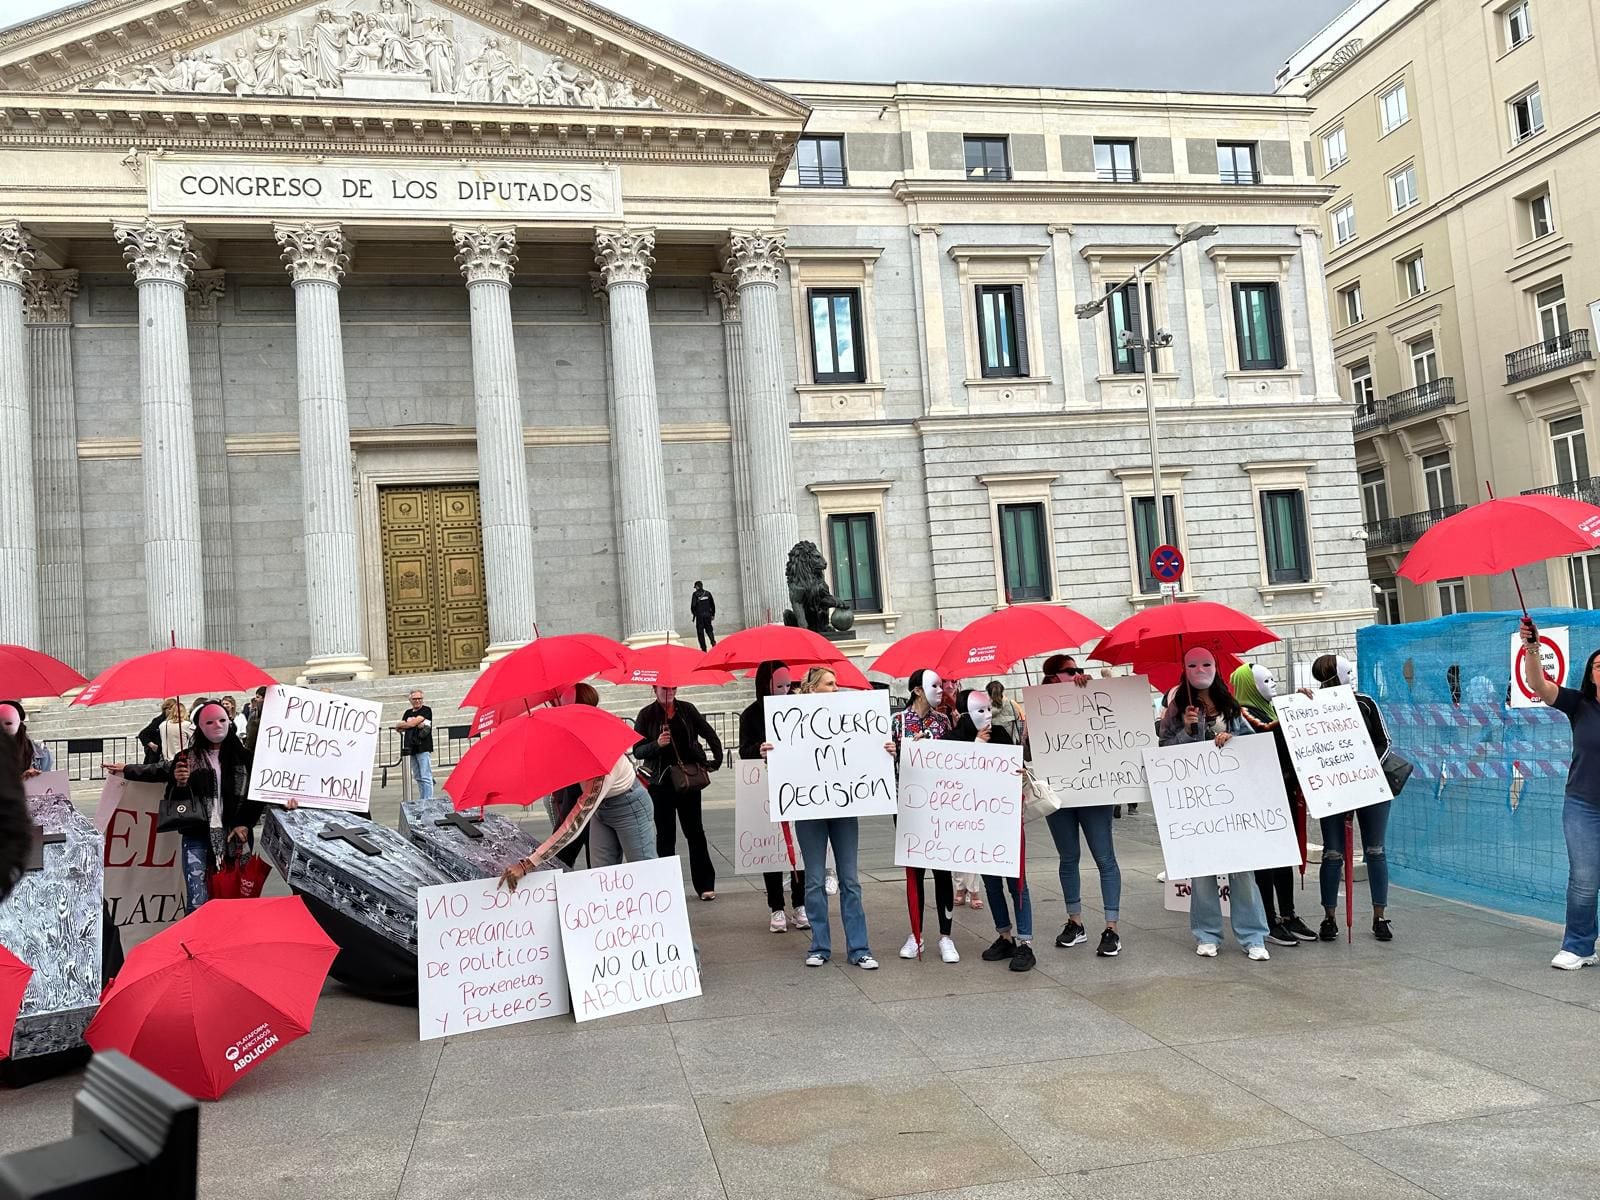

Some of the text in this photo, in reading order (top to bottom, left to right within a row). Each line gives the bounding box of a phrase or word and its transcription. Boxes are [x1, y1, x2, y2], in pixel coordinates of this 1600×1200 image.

[180, 176, 593, 202] CONGRESO DE LOS DIPUTADOS
[1038, 691, 1114, 717] DEJAR
[1089, 714, 1118, 730] DE
[1305, 722, 1318, 736] ES
[1318, 717, 1360, 735] TRABAJO
[1039, 730, 1151, 754] JUZGARNOS
[1294, 739, 1354, 760] NEGARNOS ESE
[1153, 748, 1240, 784] SOMOS
[1317, 752, 1355, 769] DERECHO
[259, 768, 311, 792] DOBLE
[1308, 774, 1324, 791] ES
[1166, 783, 1235, 810] LIBRES
[1169, 807, 1288, 840] ESCUCHARNOS
[592, 956, 621, 983] NO
[235, 1022, 269, 1047] PLATAFORMA
[242, 1028, 271, 1052] AFECTADOS
[233, 1034, 280, 1073] ABOLICIÓN
